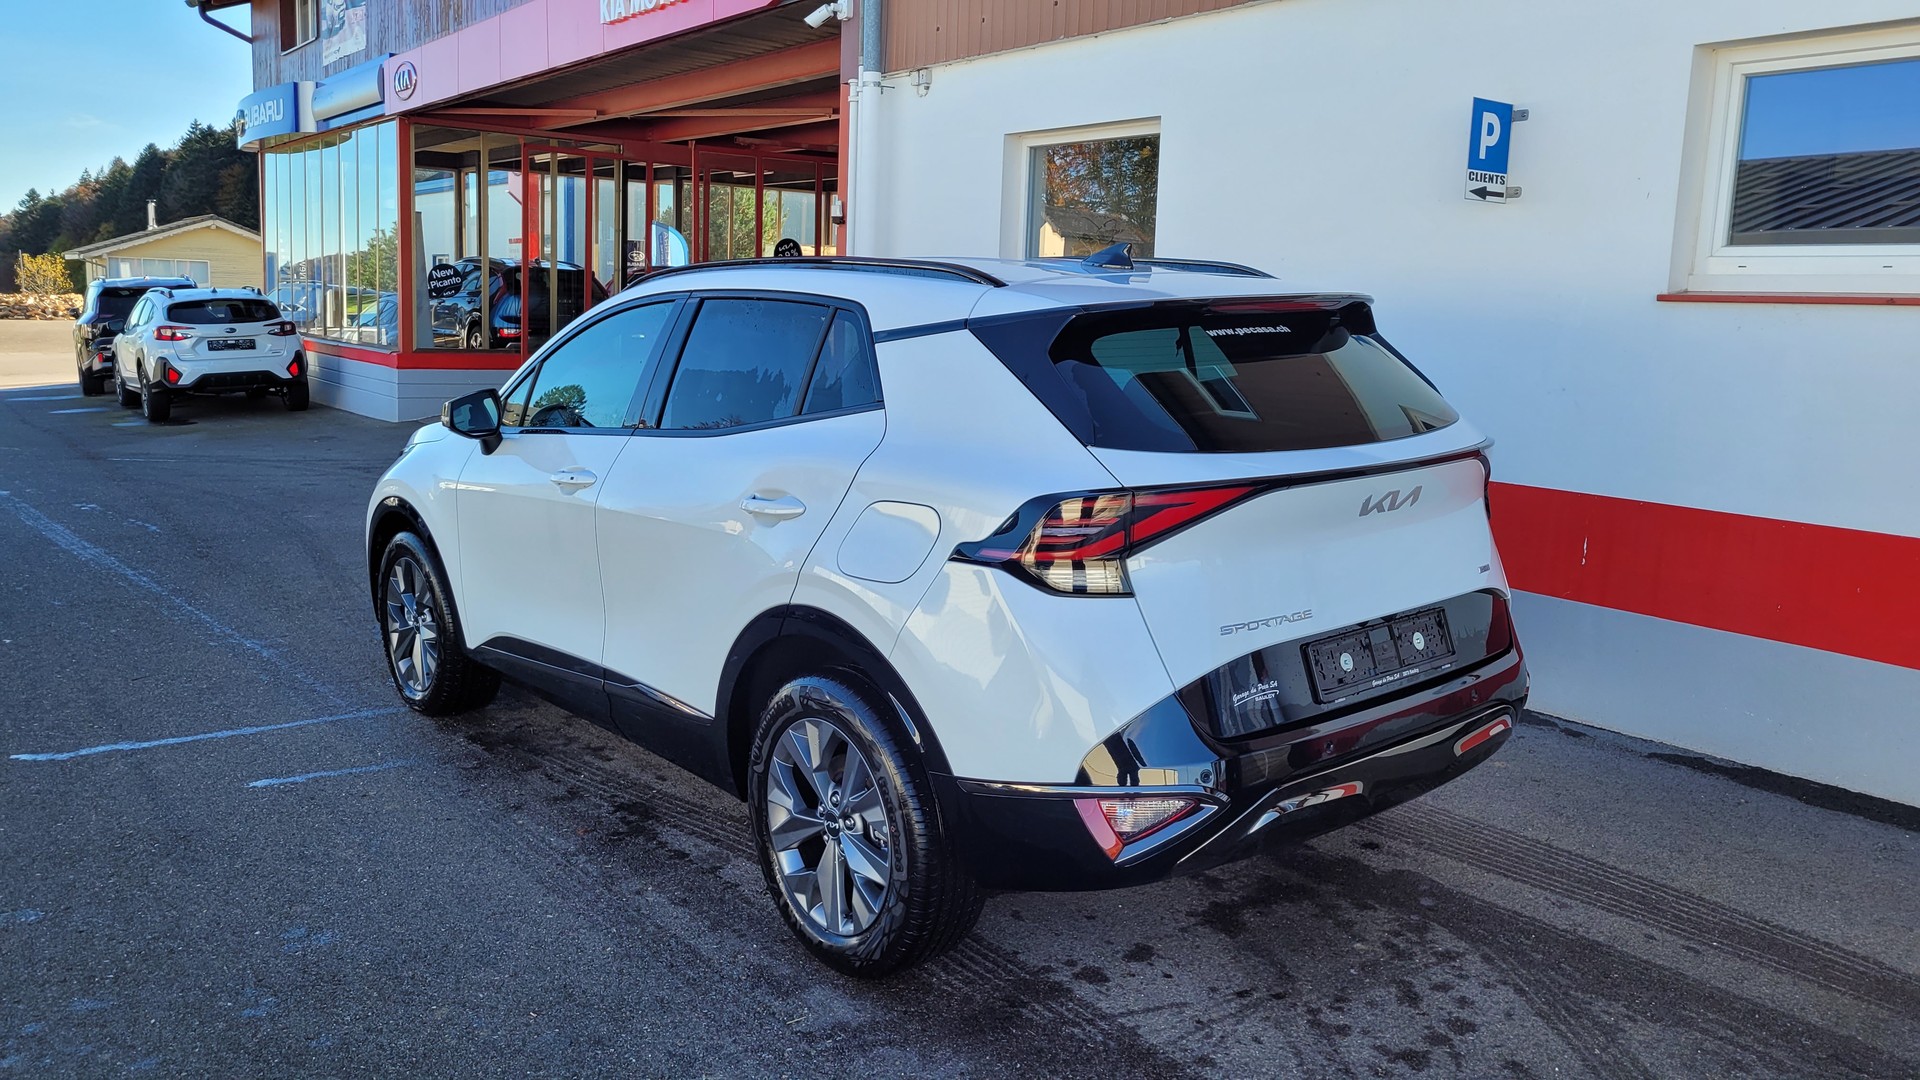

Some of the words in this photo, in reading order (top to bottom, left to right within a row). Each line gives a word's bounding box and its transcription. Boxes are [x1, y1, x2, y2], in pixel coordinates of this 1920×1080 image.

[395, 69, 412, 92] KIA
[1479, 111, 1501, 160] P
[1468, 171, 1506, 185] CLIENTS
[432, 268, 454, 279] New
[430, 277, 462, 289] Picanto
[1206, 324, 1292, 337] www.pecasa.ch
[1359, 485, 1423, 517] KIA
[1220, 609, 1313, 636] SPORTAGE
